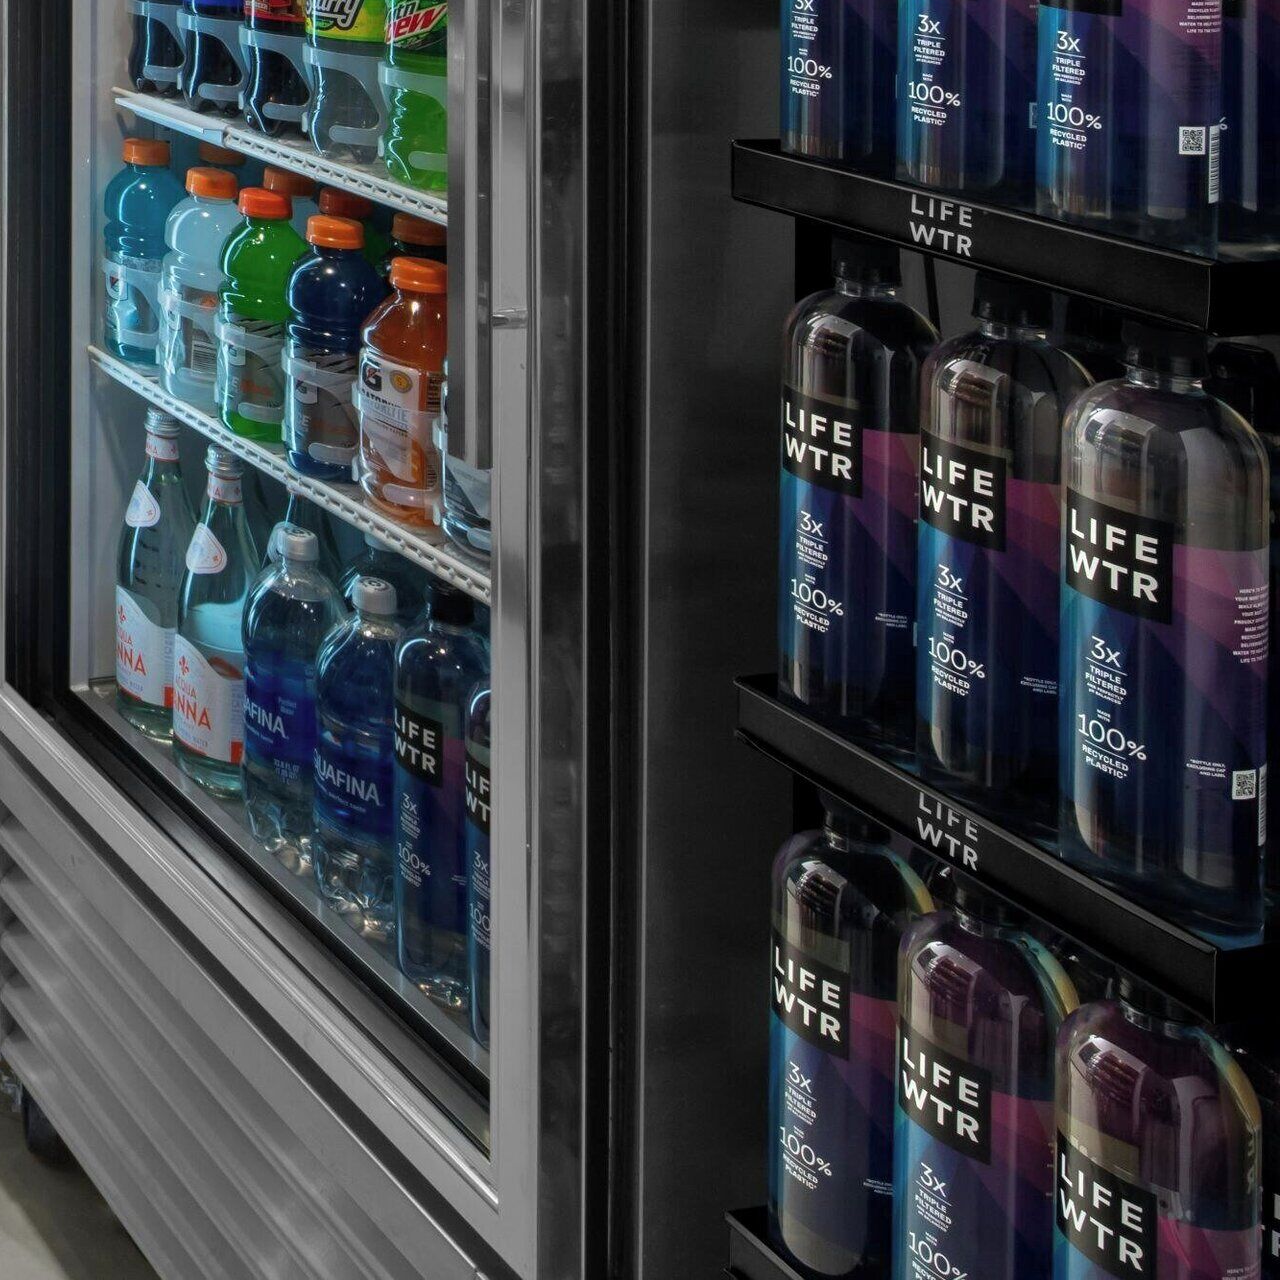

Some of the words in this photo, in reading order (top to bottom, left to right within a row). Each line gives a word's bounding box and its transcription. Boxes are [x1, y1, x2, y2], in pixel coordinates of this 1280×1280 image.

[791, 22, 819, 33] FILTERED
[794, 15, 815, 25] TRIPLE
[913, 45, 946, 58] FILTERED
[916, 38, 941, 49] TRIPLE
[1055, 56, 1081, 68] TRIPLE
[787, 55, 833, 79] 100%
[789, 78, 821, 91] RECYCLED
[1052, 63, 1086, 76] FILTERED
[908, 80, 961, 108] 100%
[911, 105, 947, 120] RECYCLED
[1046, 101, 1103, 130] 100%
[1049, 127, 1088, 143] RECYCLED
[910, 193, 973, 229] LIFE
[909, 220, 973, 258] WTR
[784, 400, 853, 448] LIFE
[784, 432, 852, 481] WTR
[922, 446, 995, 498] LIFE
[922, 480, 995, 534] WTR
[1070, 506, 1160, 566] LIFE
[1070, 543, 1160, 604] WTR
[790, 578, 845, 617] 100%
[117, 644, 148, 677] NNA
[927, 635, 986, 681] 100%
[1089, 664, 1122, 685] TRIPLE
[1084, 671, 1128, 697] FILTERED
[173, 696, 212, 732] NNA
[242, 694, 289, 739] AFINA
[393, 707, 436, 750] LIFE
[393, 730, 436, 775] WTR
[1077, 713, 1148, 762] 100%
[1081, 743, 1130, 772] RECYCLED
[313, 748, 382, 807] QUAFINA
[464, 761, 491, 794] LIF
[464, 784, 491, 822] WT
[918, 791, 979, 843] LIFE
[397, 841, 431, 877] 100%
[916, 815, 979, 872] WTR
[774, 945, 841, 1010] LIFE
[774, 977, 841, 1044] WTR
[903, 1035, 980, 1109] LIFE
[902, 1069, 980, 1144] WTR
[779, 1125, 833, 1178] 100%
[1060, 1152, 1144, 1234] LIFE
[1059, 1187, 1144, 1272] WTR
